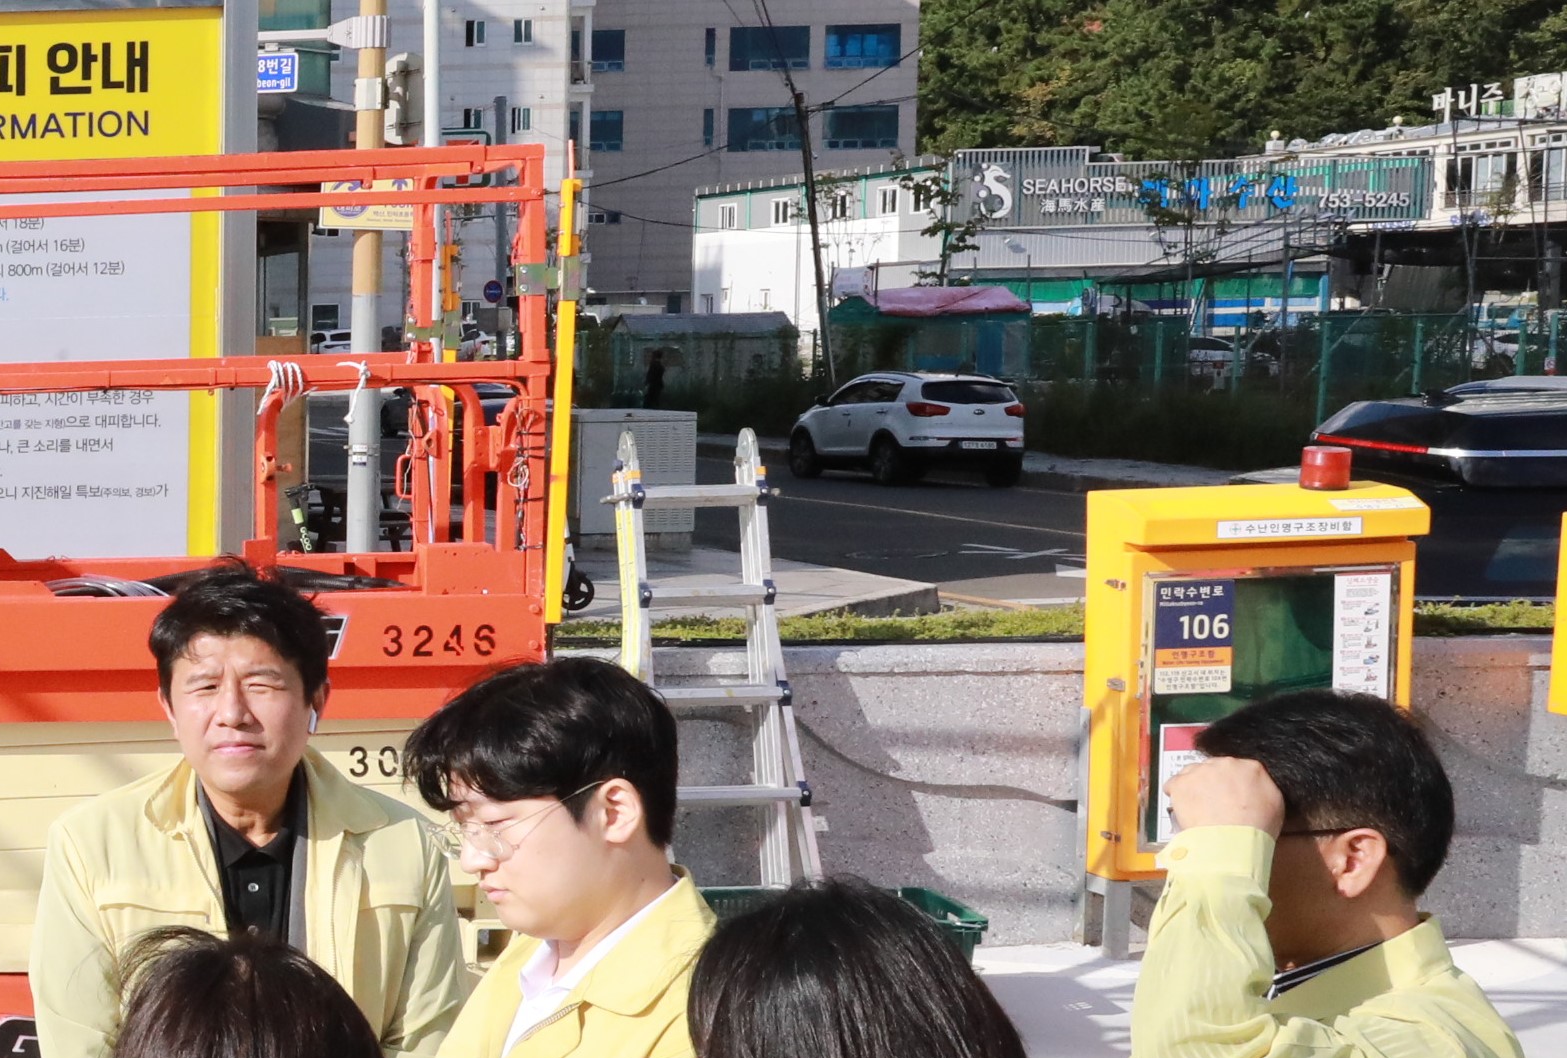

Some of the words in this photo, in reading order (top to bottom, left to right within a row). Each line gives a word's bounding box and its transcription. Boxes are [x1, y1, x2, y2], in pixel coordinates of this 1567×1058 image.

[45, 41, 150, 96] 안내
[1022, 176, 1127, 195] SEAHORSE
[1317, 191, 1411, 208] 753-5245
[6, 239, 48, 255] (걸어서
[53, 238, 86, 254] 16분)
[8, 263, 44, 278] 800m
[45, 261, 89, 277] (걸어서
[94, 260, 126, 276] 12분)
[45, 391, 83, 408] 시간이
[129, 389, 155, 406] 경우
[95, 413, 162, 430] 대피합니다.
[16, 439, 31, 454] 큰
[33, 437, 73, 454] 소리를
[75, 437, 114, 453] 내면서
[22, 484, 72, 501] 지진해일
[1245, 520, 1353, 535] 수난인명구조장비함
[1160, 585, 1224, 600] 민락수변로
[1179, 613, 1230, 640] 106
